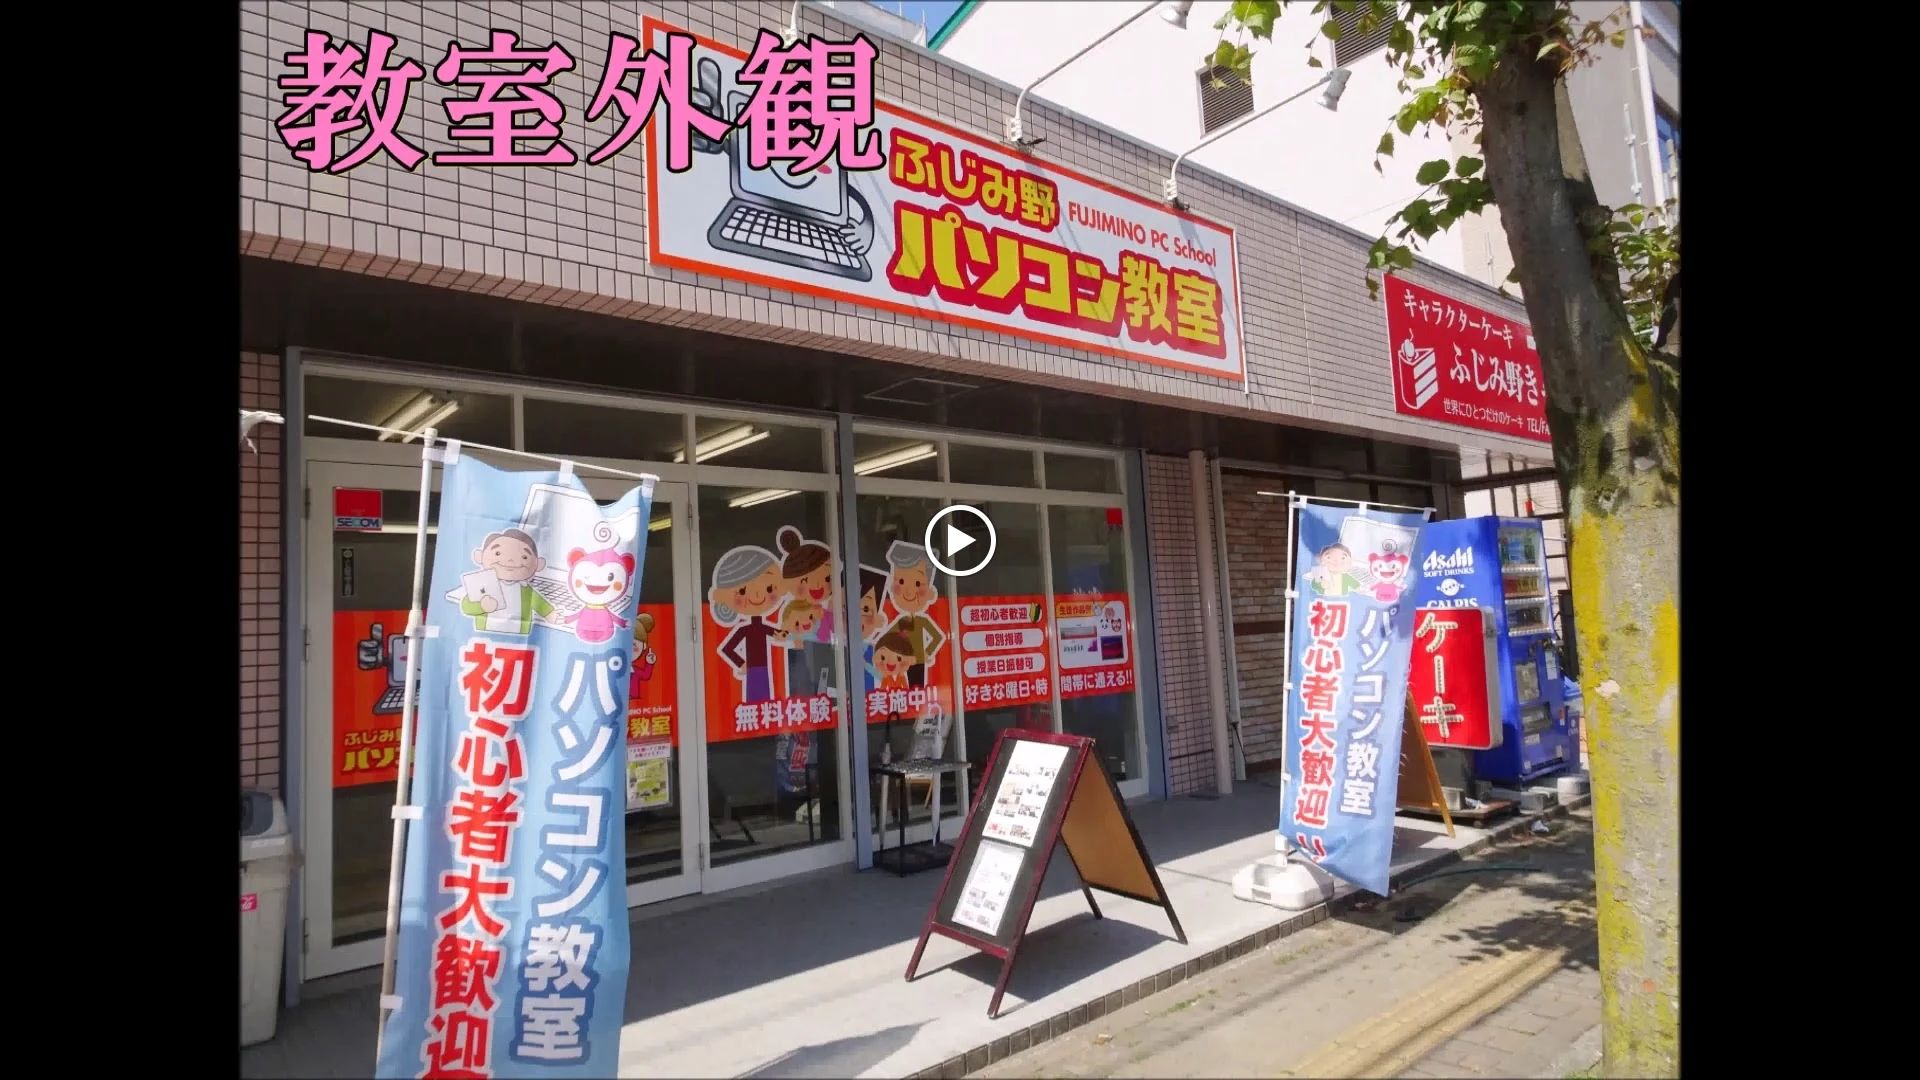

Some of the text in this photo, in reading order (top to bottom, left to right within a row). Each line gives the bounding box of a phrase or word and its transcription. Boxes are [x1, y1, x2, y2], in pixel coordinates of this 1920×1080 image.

[892, 131, 1057, 230] ふじみ野
[1069, 201, 1217, 268] FUJIMINO PC School
[890, 206, 1223, 350] パソコン教室
[1403, 289, 1514, 349] キャラクターケーキ
[1450, 342, 1547, 406] ふじみ野き
[1443, 397, 1551, 437] 世界にひとつだけのケーキ TEL/FA
[1423, 546, 1474, 571] Asahi
[1424, 567, 1475, 578] SOFT DRINKS
[985, 633, 1024, 647] 個別指導
[1415, 611, 1465, 739] ケーキ
[1339, 606, 1398, 817] パソコン教室
[343, 746, 400, 771] パソ
[423, 643, 536, 1078] 初心者大歓迎
[516, 655, 626, 1062] パソコン教室
